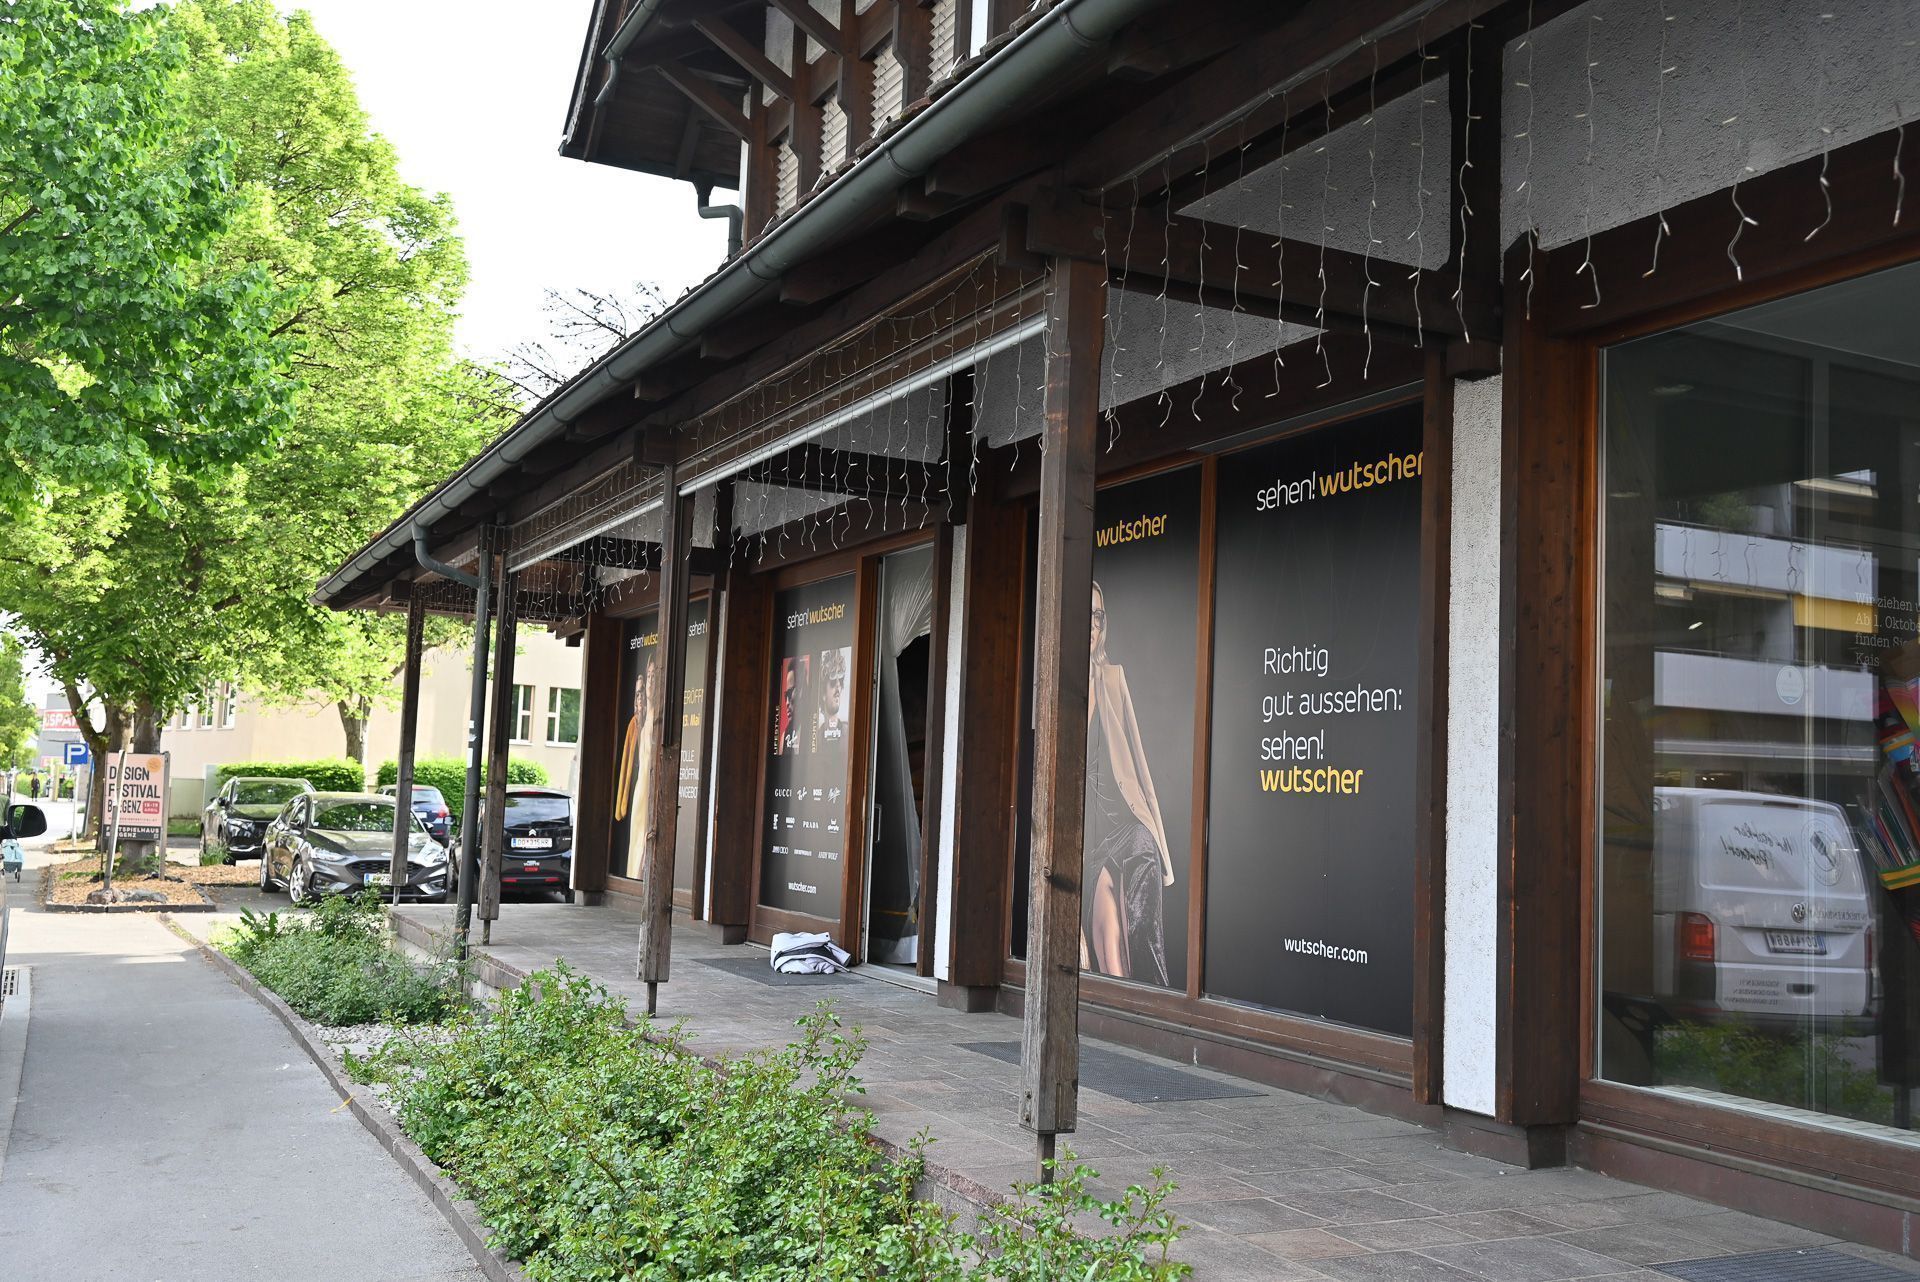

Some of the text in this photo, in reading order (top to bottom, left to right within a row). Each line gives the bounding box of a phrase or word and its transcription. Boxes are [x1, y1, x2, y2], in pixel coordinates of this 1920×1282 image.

[1256, 451, 1423, 511] sehen! wutscher
[1096, 513, 1167, 548] wutscher
[1877, 596, 1913, 611] ziehen
[809, 603, 845, 624] wutscher
[1855, 612, 1871, 626] Ab
[1855, 632, 1890, 649] finden
[1263, 644, 1329, 678] Richtig
[1262, 686, 1402, 724] gut aussehen:
[67, 745, 86, 764] P
[1261, 729, 1324, 762] sehen!
[109, 766, 150, 781] DSIGN
[1260, 765, 1363, 795] wutscher
[108, 784, 161, 799] FSTIVAL
[774, 788, 792, 798] GUCCI
[108, 800, 141, 814] BGENZ
[106, 825, 160, 834] FTSPIELHAUS
[802, 820, 819, 830] PRADA
[1284, 936, 1368, 965] wutscher.com
